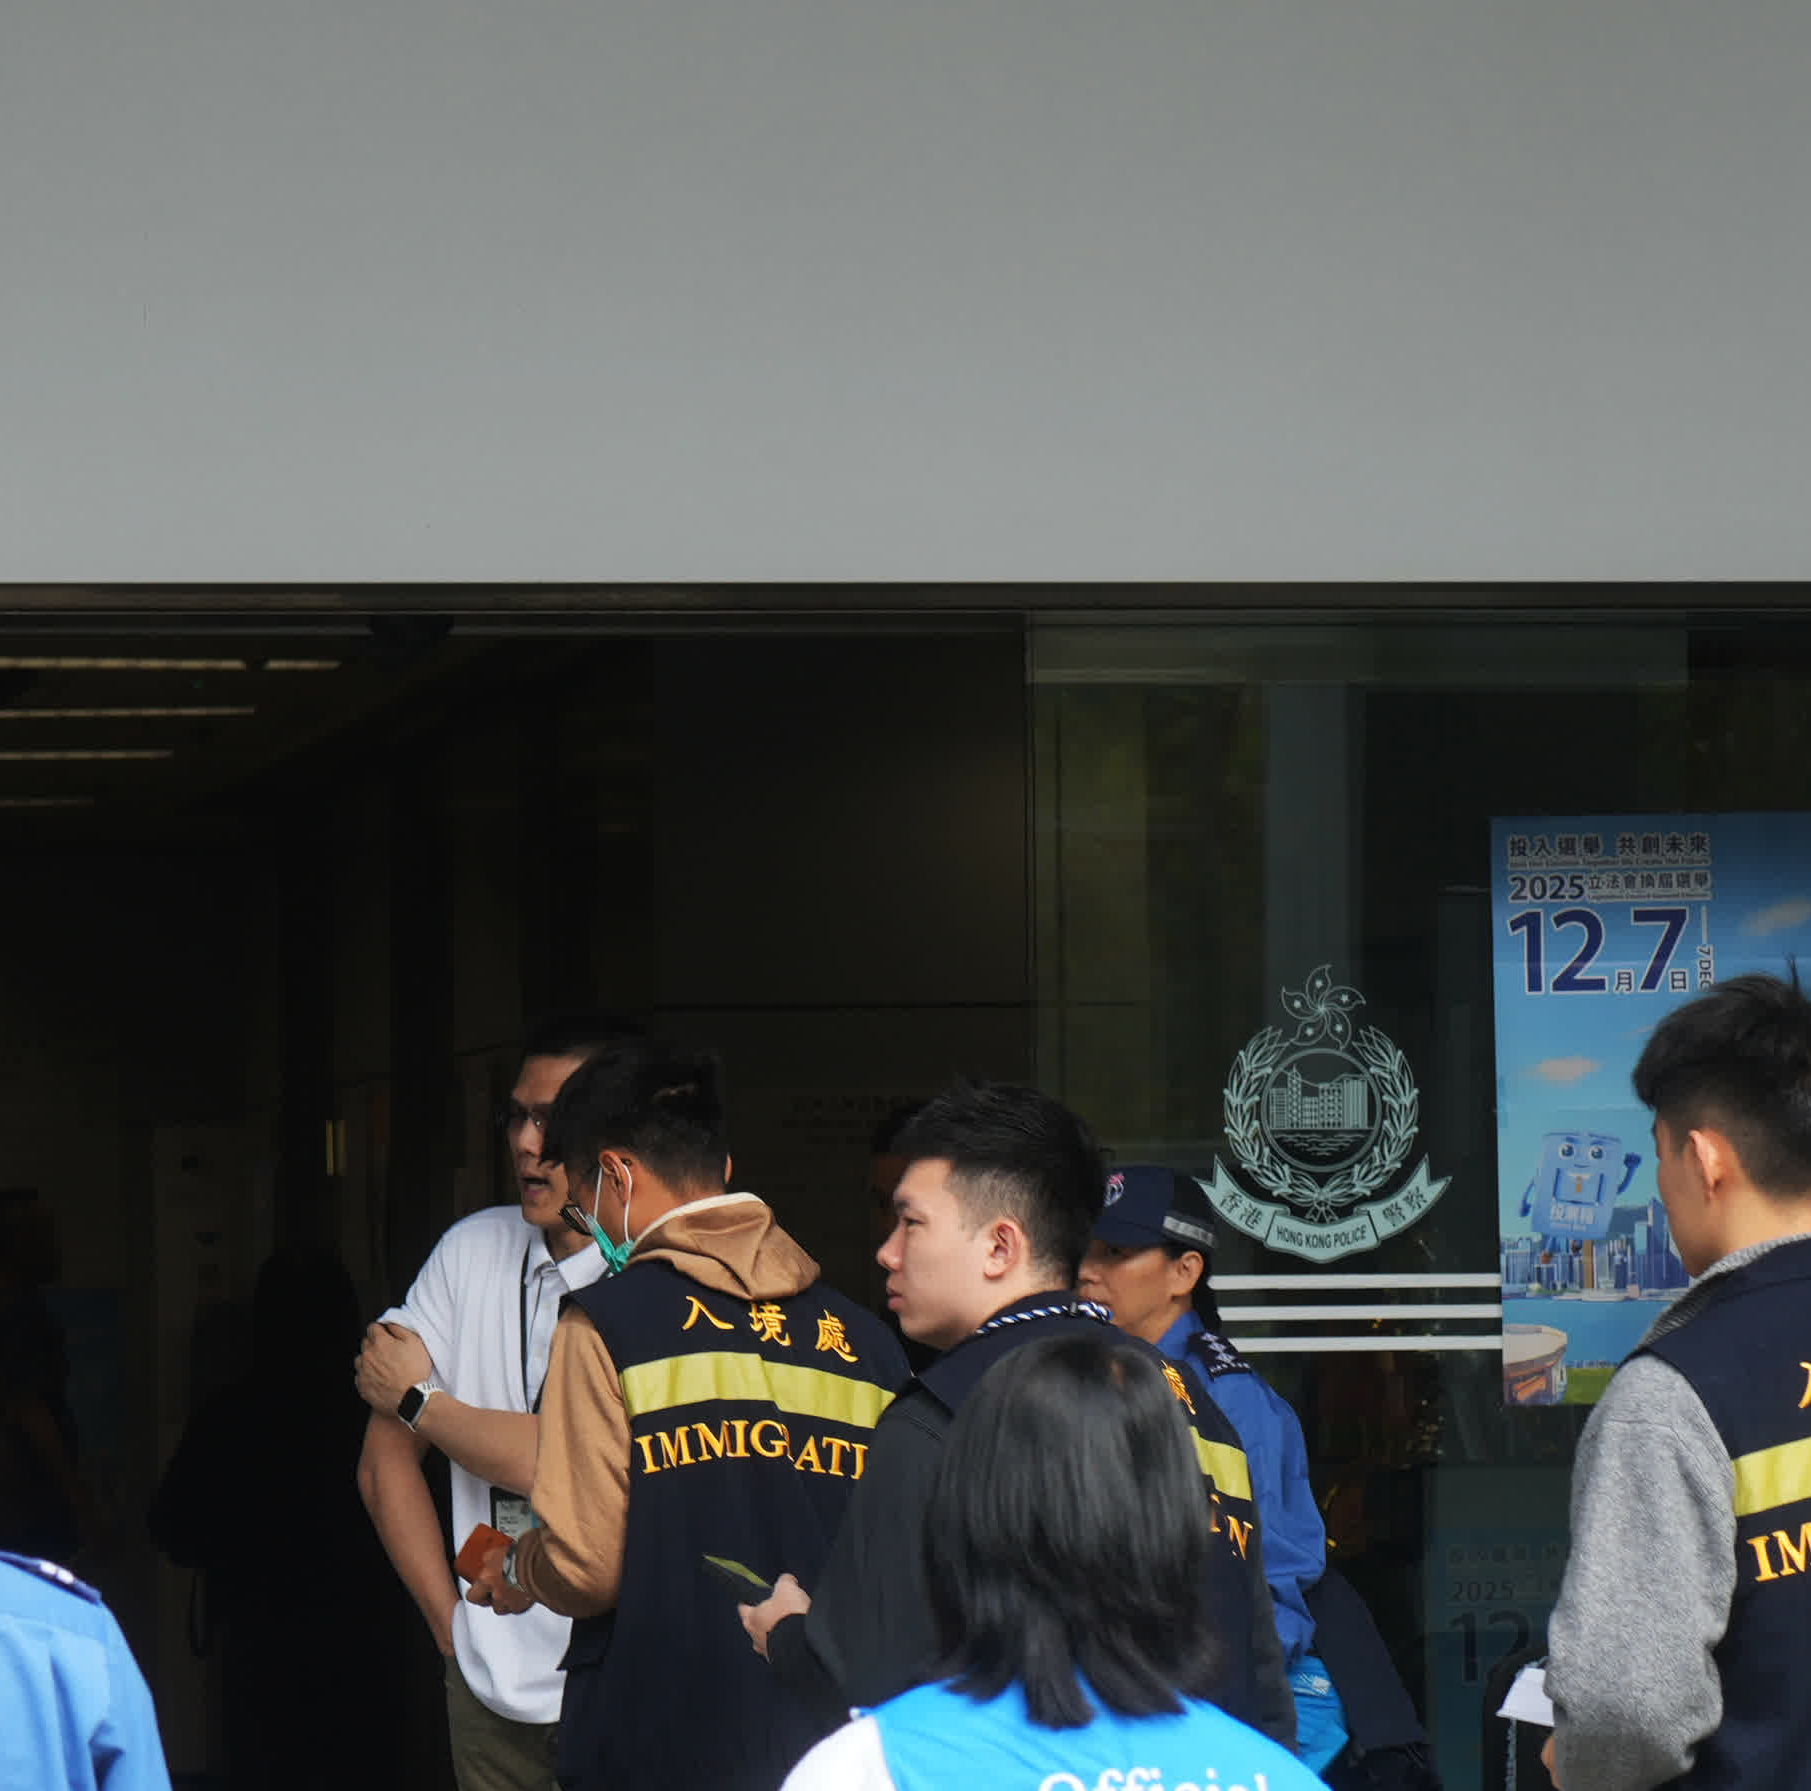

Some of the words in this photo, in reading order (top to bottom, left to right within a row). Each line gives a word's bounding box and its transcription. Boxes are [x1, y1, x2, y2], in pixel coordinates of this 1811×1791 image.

[1510, 874, 1585, 900] 2025
[1276, 1224, 1303, 1247] HONG
[1305, 1233, 1331, 1249] KONG
[1333, 1223, 1367, 1248] POLICE
[681, 1294, 859, 1363] 入境處
[635, 1419, 869, 1480] IMMIGATI
